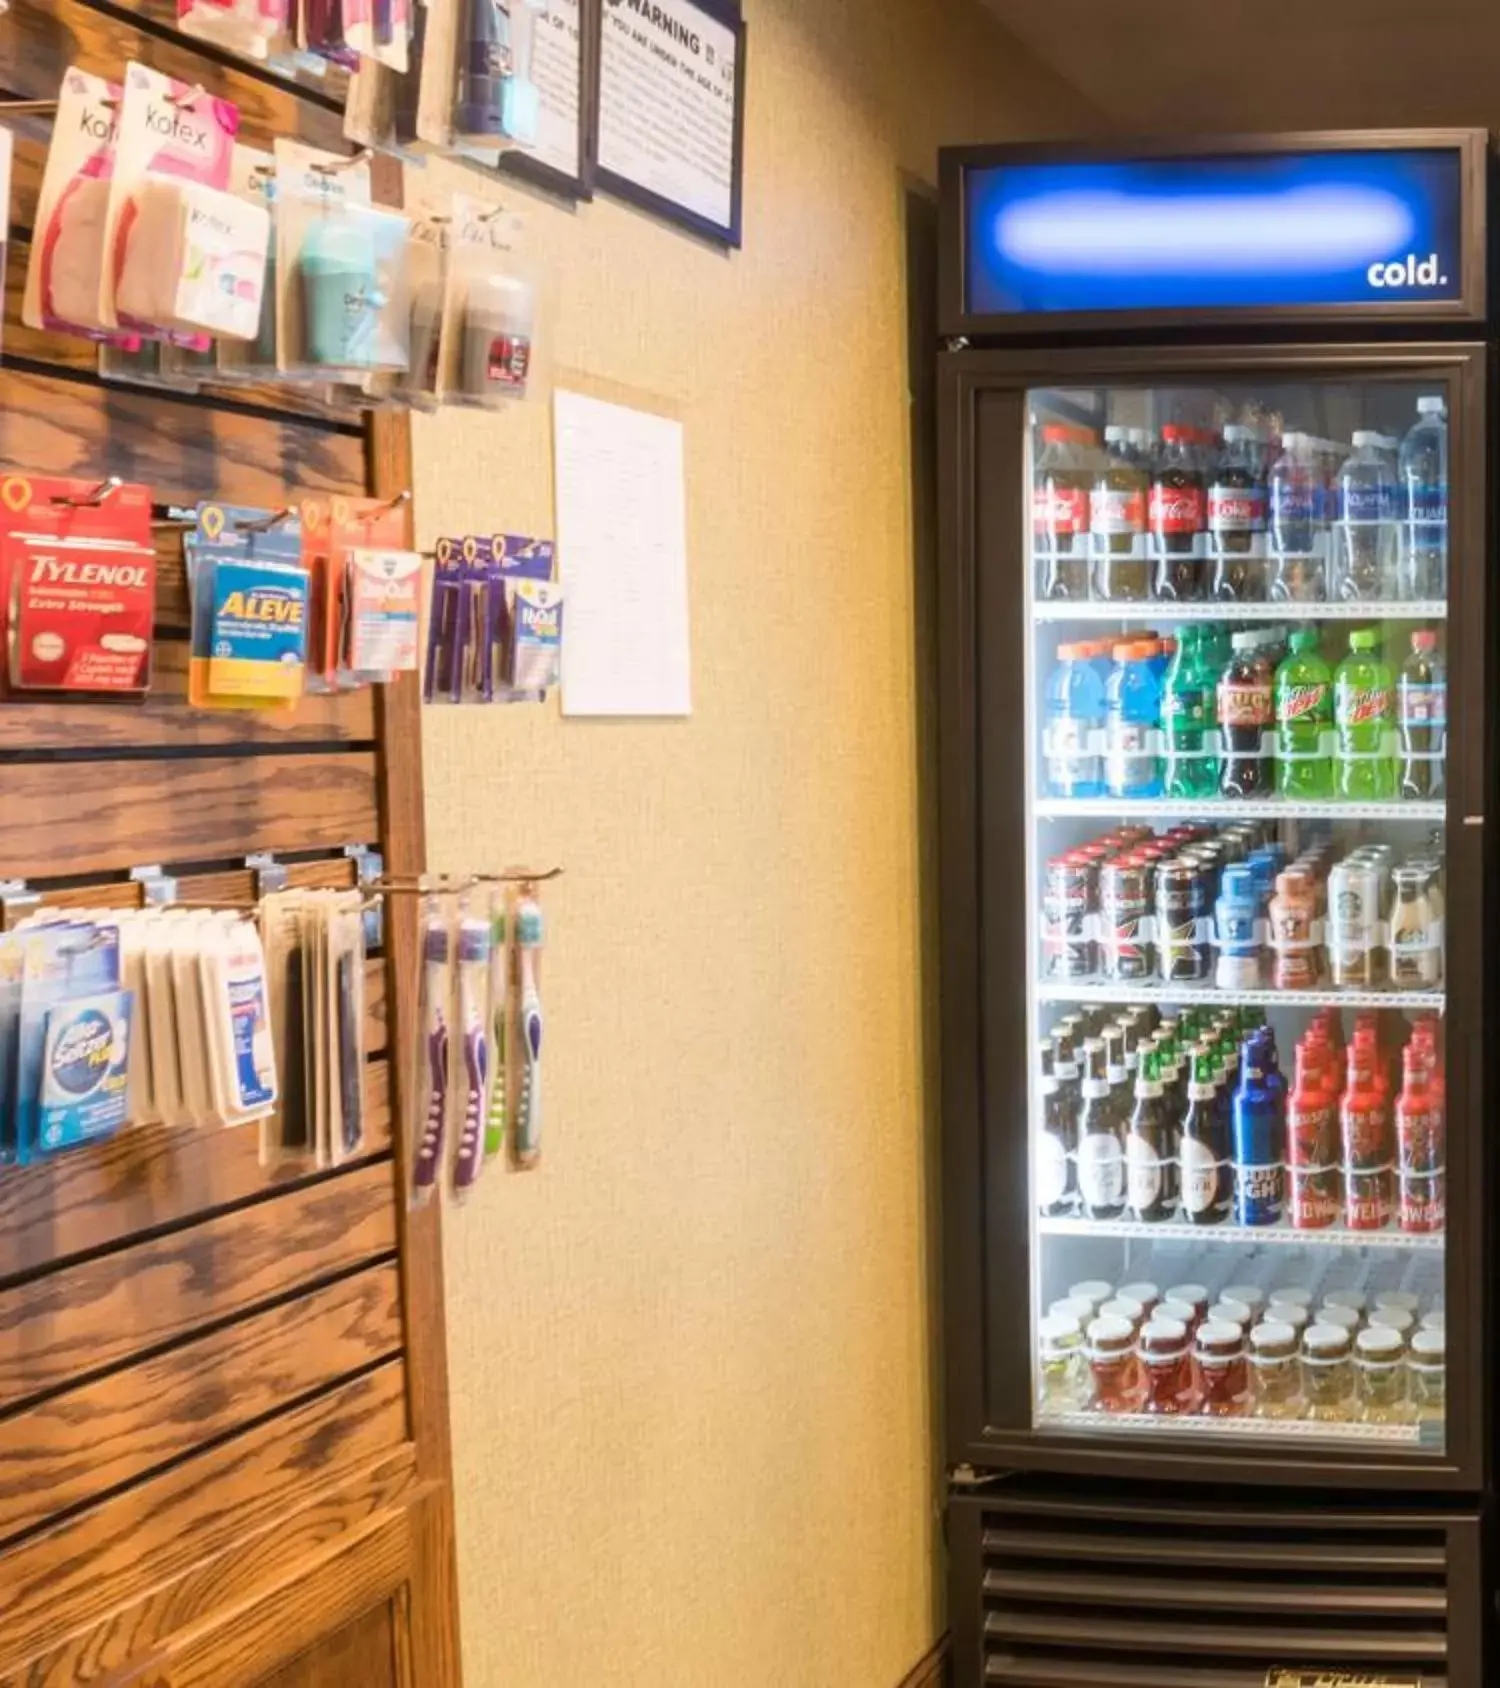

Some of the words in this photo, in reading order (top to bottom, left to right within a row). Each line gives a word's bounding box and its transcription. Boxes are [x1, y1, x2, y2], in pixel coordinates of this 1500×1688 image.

[626, 0, 700, 55] WARNING
[79, 106, 119, 143] Kot
[1367, 253, 1448, 288] cold.
[28, 555, 148, 587] TYLENOL
[216, 590, 305, 624] ALEVE
